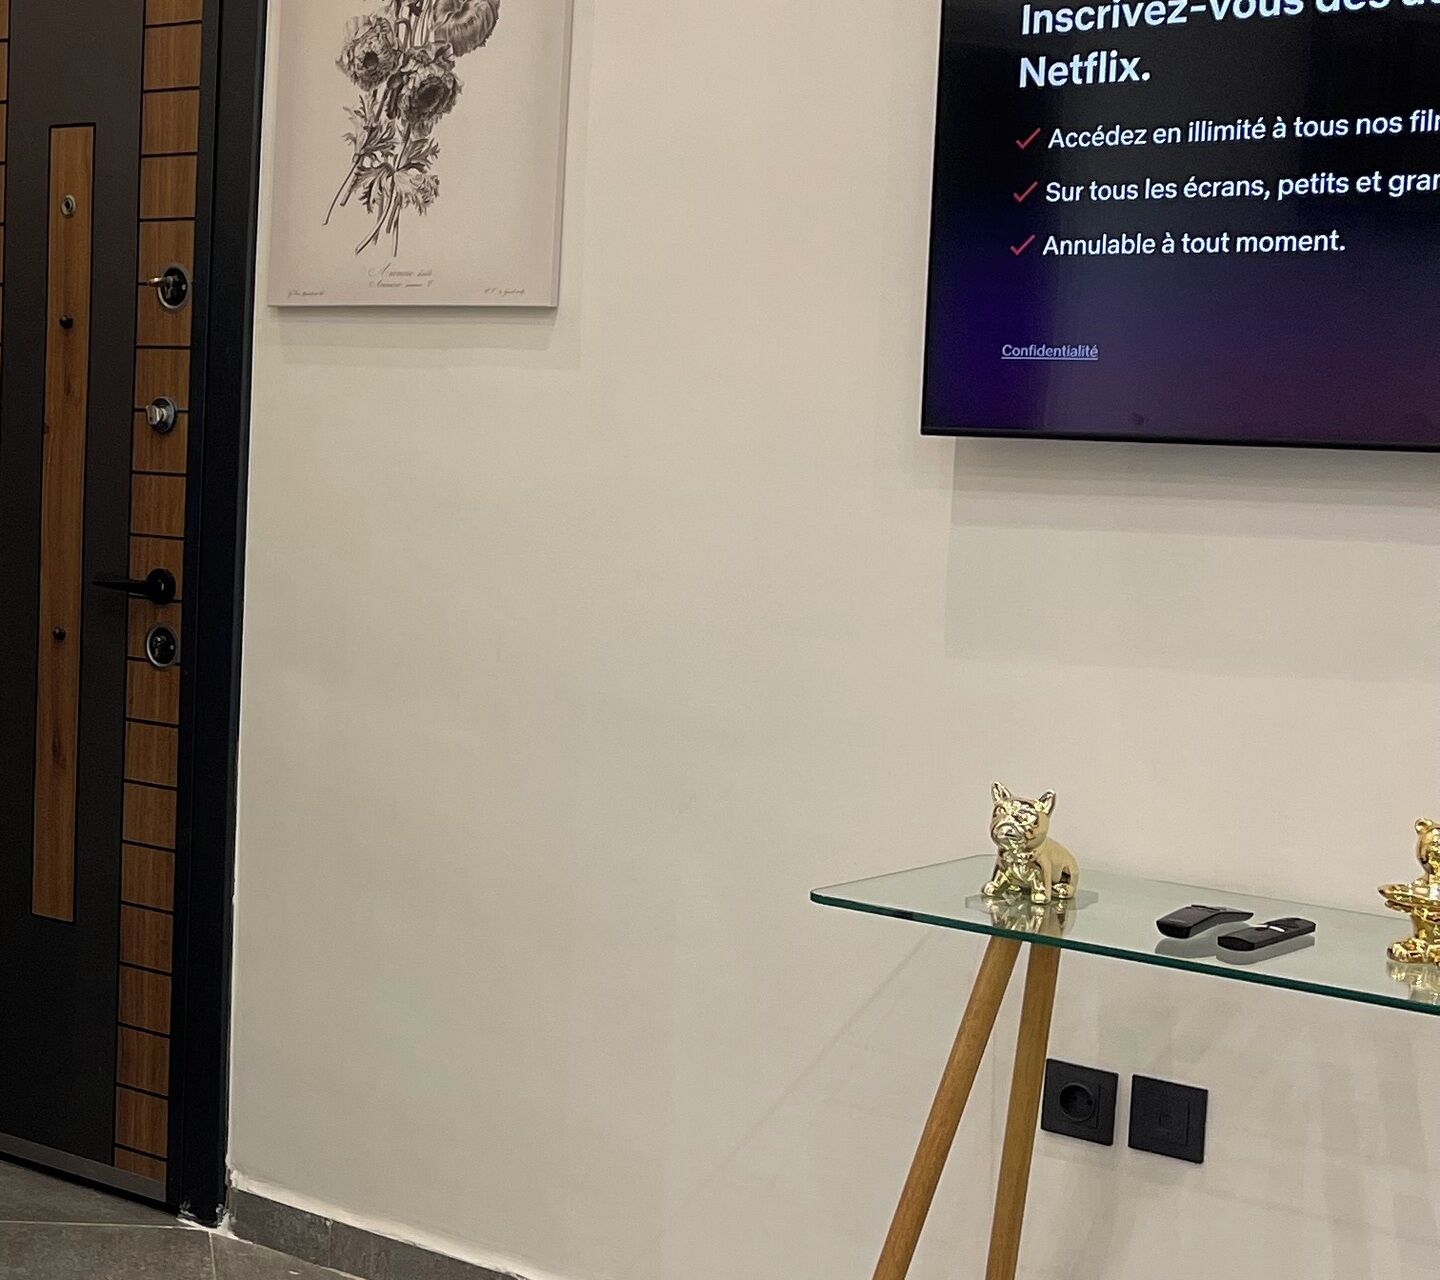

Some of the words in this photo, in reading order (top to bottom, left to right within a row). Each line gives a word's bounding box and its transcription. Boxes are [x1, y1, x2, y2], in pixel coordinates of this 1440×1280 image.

[1019, 49, 1152, 89] Netflix.
[1047, 124, 1148, 150] Accédez
[1152, 126, 1182, 145] en
[1187, 117, 1267, 143] illimité
[1272, 115, 1287, 139] à
[1293, 115, 1349, 138] tous
[1355, 115, 1403, 136] nos
[1409, 108, 1440, 133] fil
[1045, 181, 1085, 203] Sur
[1088, 180, 1139, 201] tous
[1144, 177, 1178, 200] les
[1183, 175, 1271, 202] écrans,
[1277, 171, 1350, 202] petits
[1355, 169, 1383, 194] et
[1042, 232, 1156, 256] Annulable
[1161, 231, 1176, 254] à
[1180, 231, 1231, 254] tout
[1235, 229, 1347, 254] moment.
[1001, 343, 1099, 361] Confidentialité
